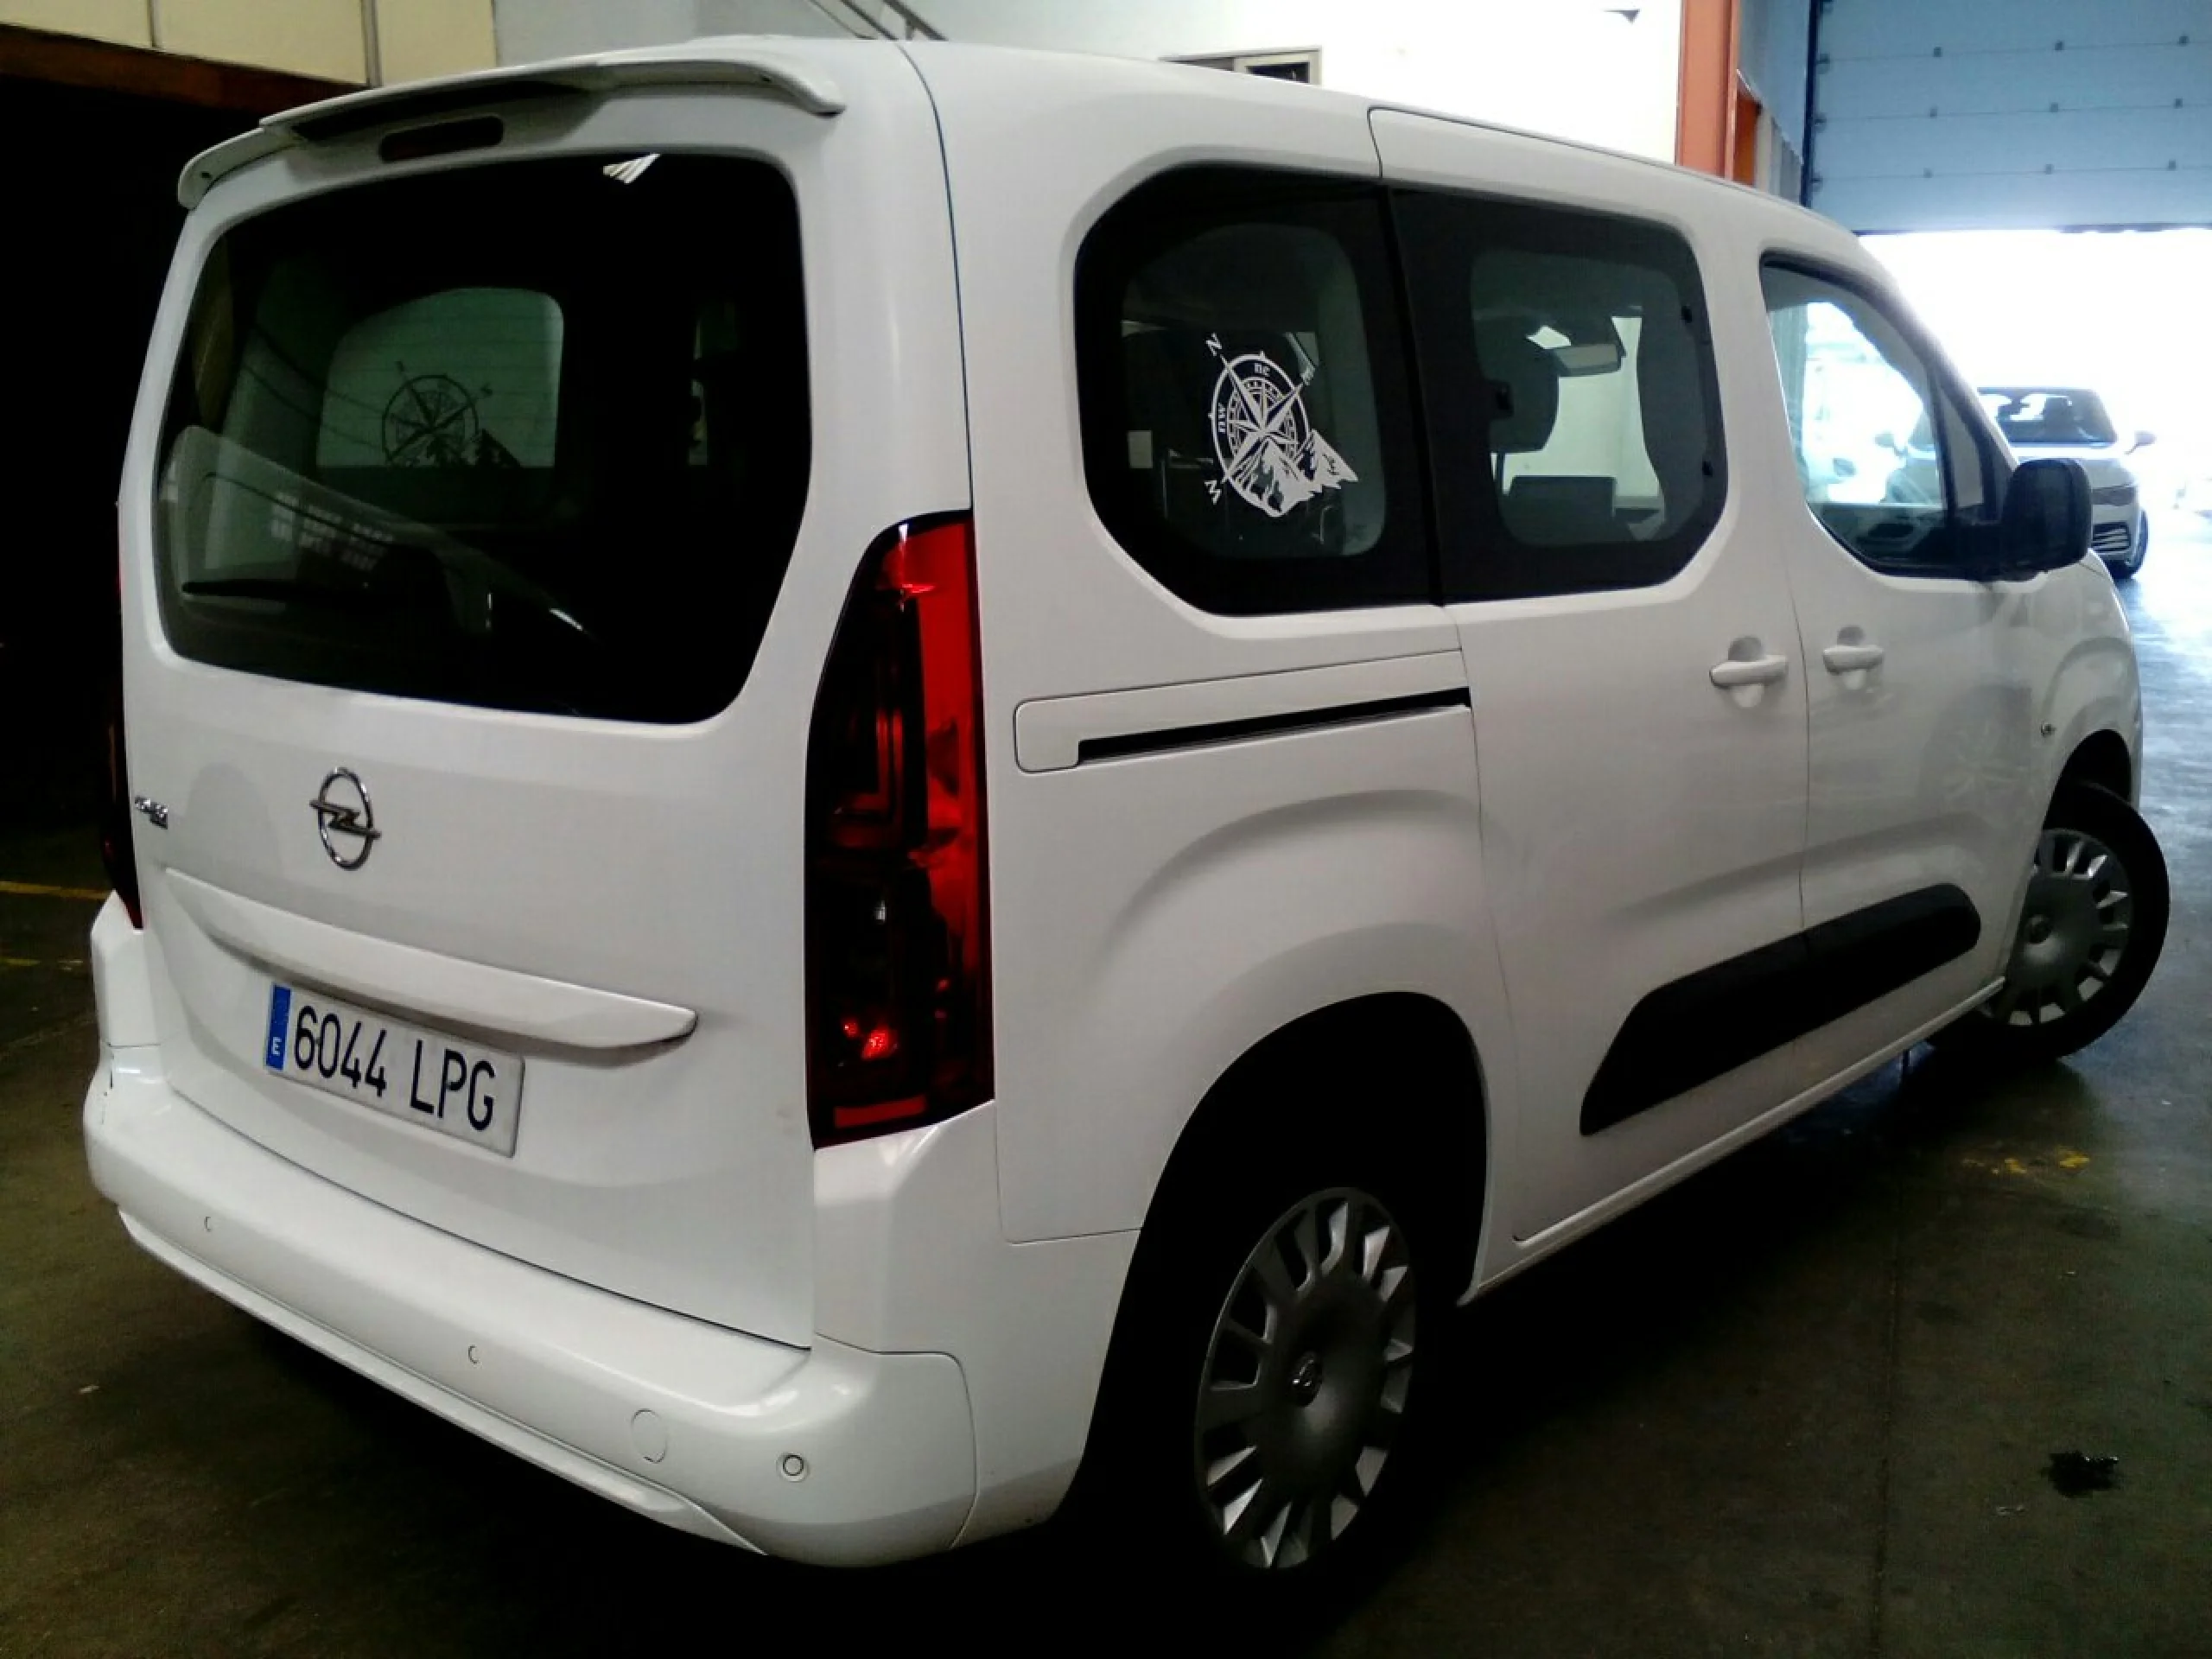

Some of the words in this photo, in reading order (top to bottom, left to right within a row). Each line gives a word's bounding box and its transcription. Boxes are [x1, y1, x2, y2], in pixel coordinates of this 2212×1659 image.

[270, 1036, 281, 1055] E
[294, 1005, 387, 1098] 6044
[410, 1039, 496, 1132] LPG
